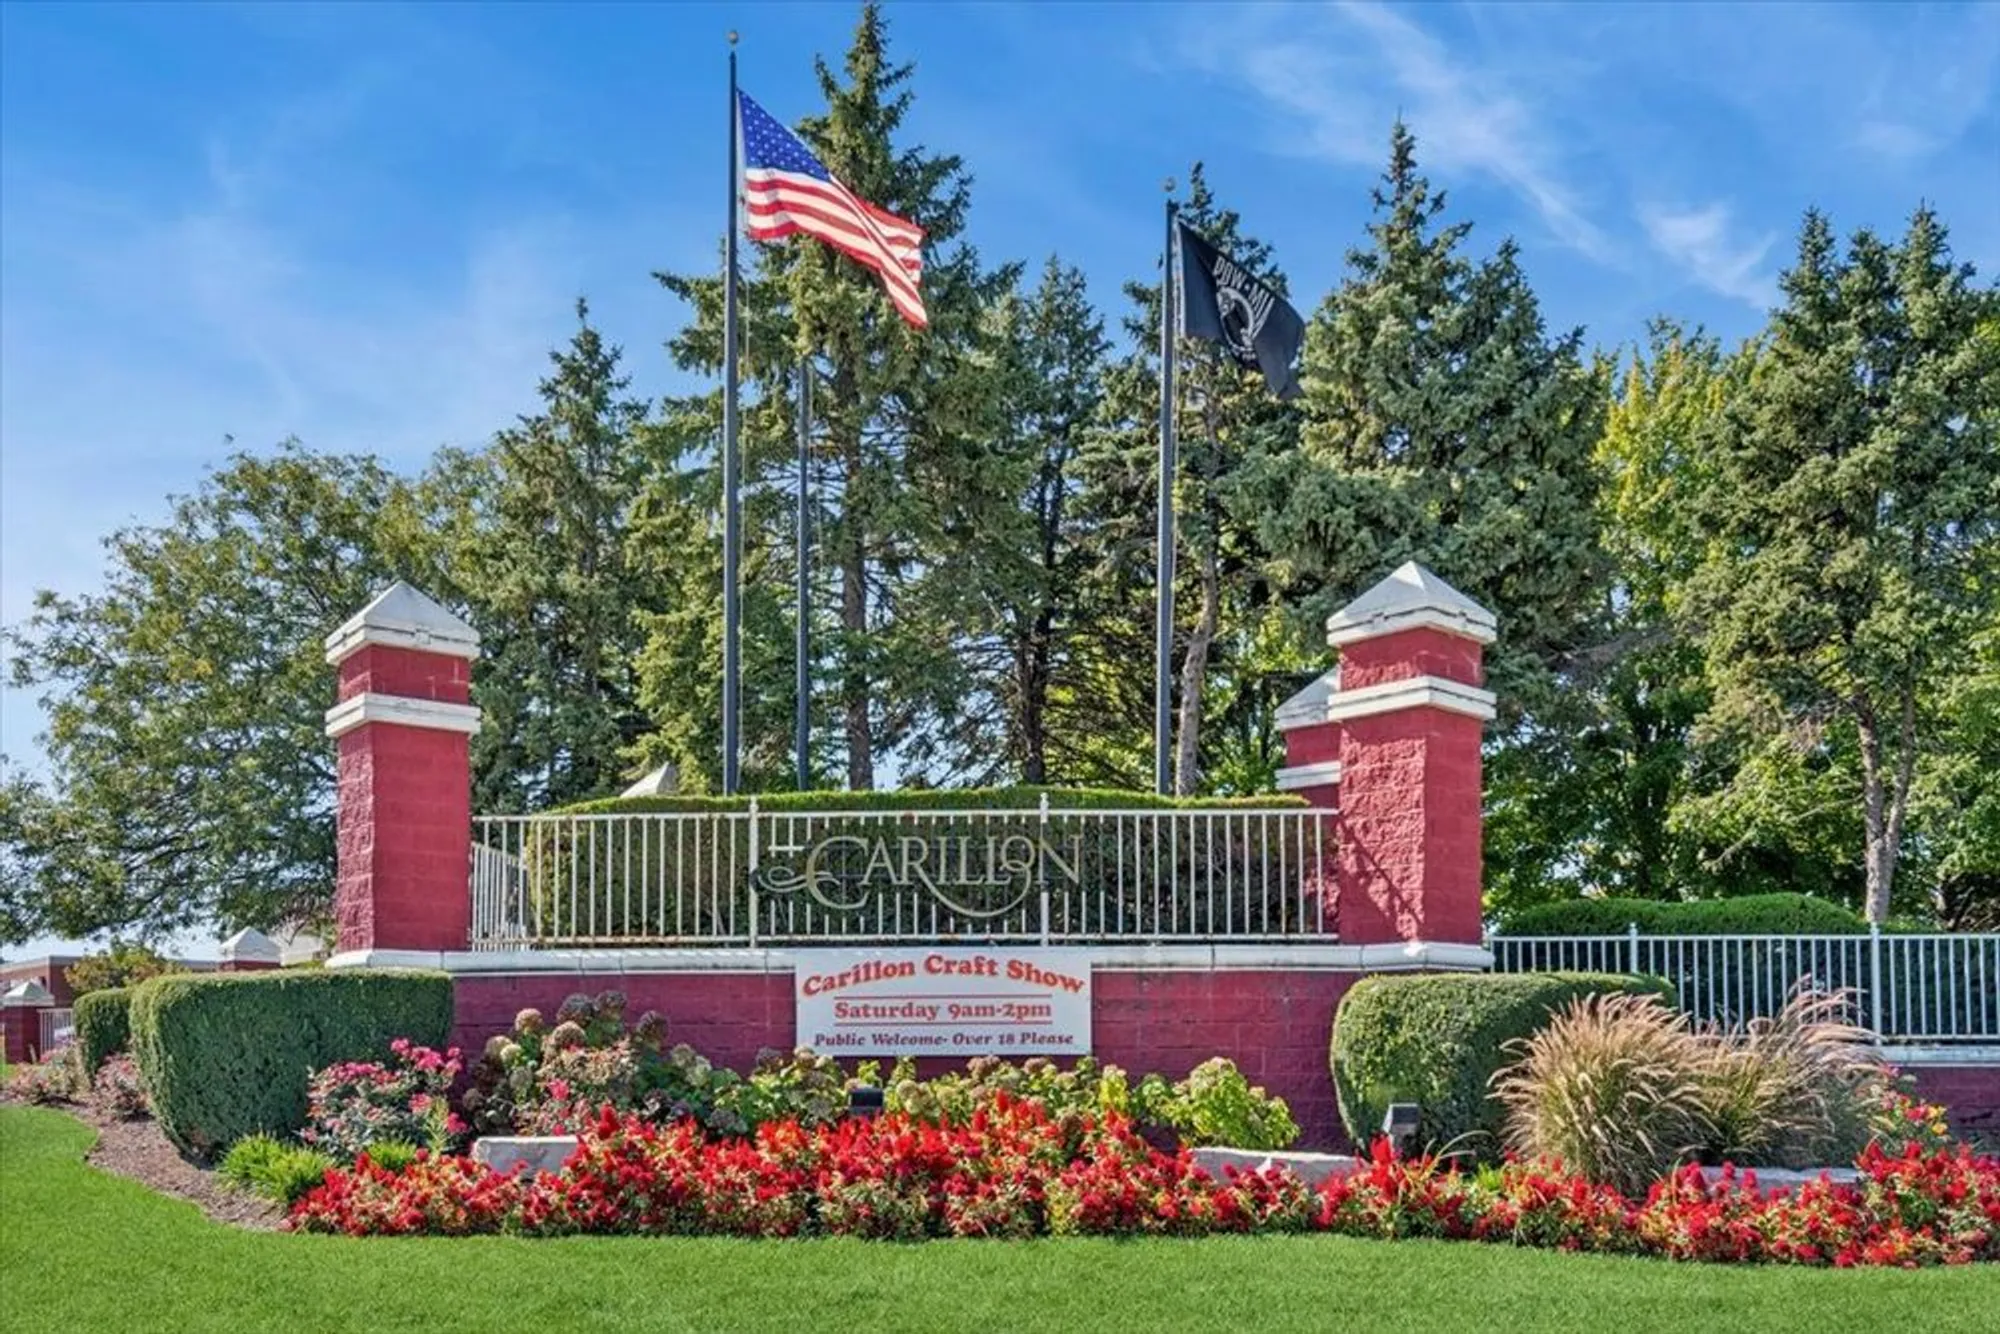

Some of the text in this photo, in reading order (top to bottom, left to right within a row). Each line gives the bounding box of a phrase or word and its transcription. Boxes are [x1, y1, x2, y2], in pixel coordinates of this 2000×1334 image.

[758, 835, 1084, 917] CARILLON
[802, 954, 1086, 996] Carillon Craft Show
[834, 1002, 1052, 1021] Saturday 9am-2pm
[813, 1031, 1074, 1047] Public Welcome- Over 18 Please
